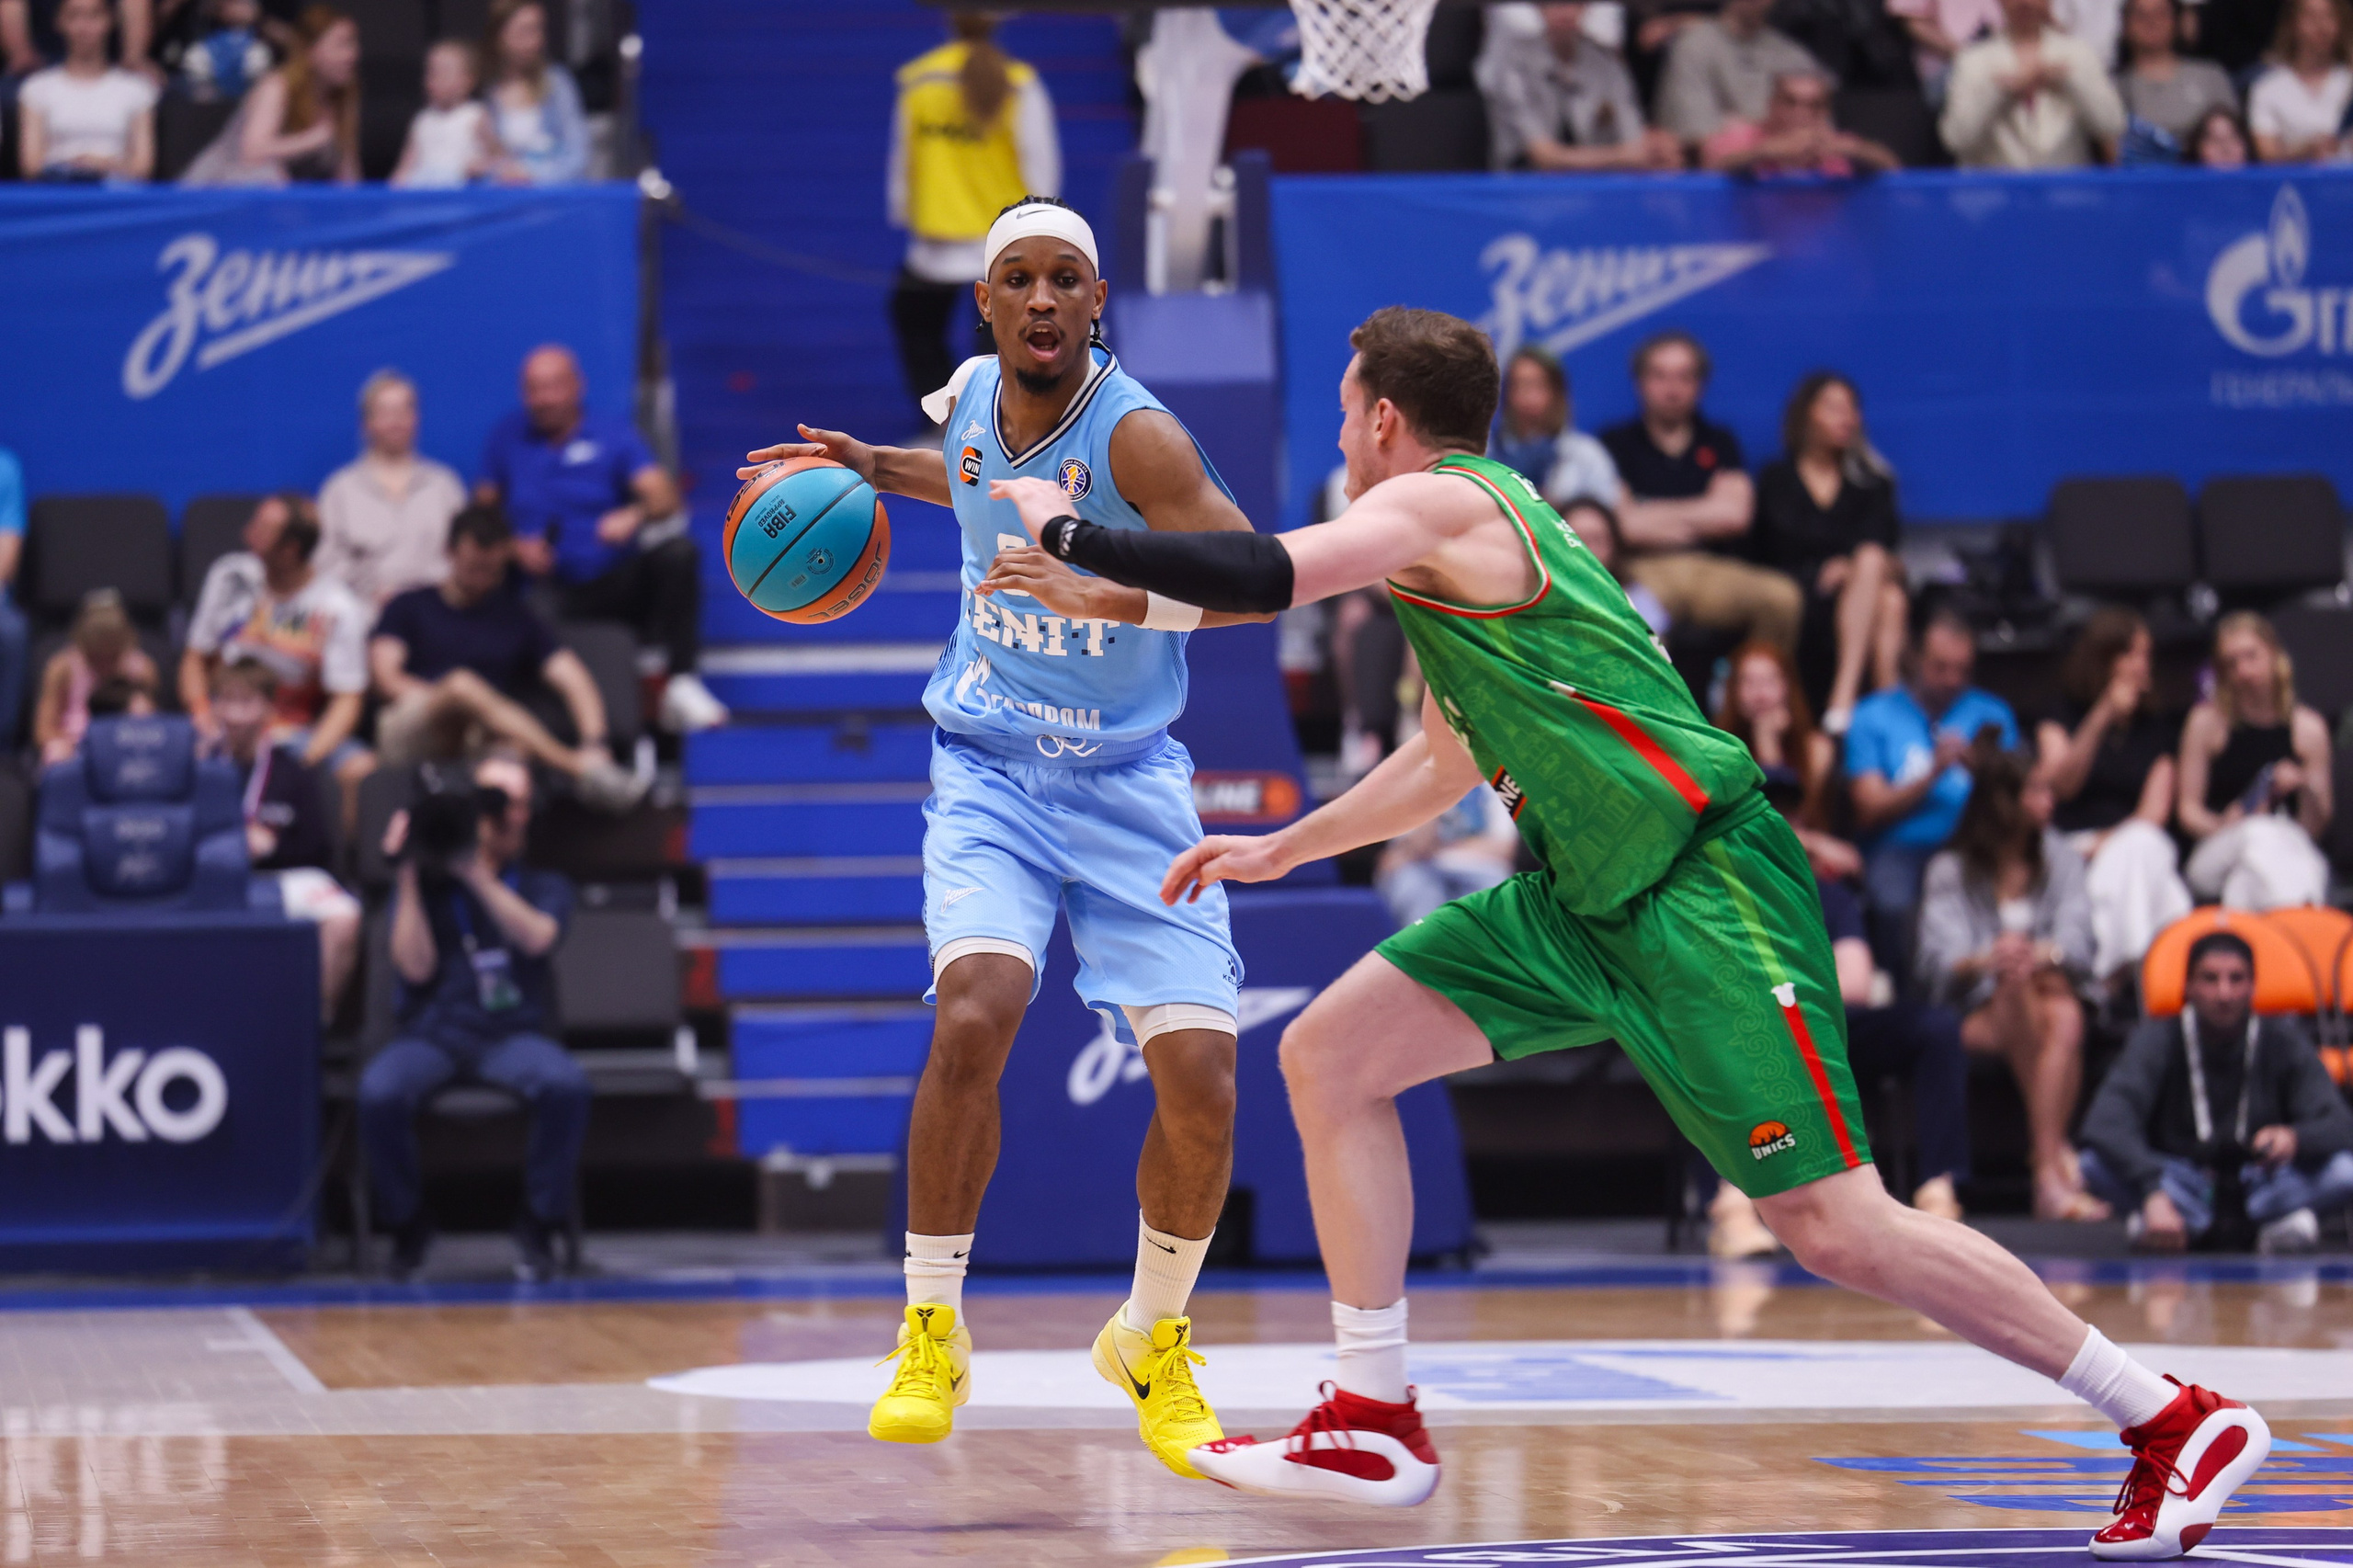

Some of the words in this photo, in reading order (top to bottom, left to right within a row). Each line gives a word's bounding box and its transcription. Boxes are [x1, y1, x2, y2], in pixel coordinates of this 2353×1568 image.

[965, 459, 981, 474] WIN
[757, 498, 785, 528] APPROVED
[763, 504, 797, 540] FIBA
[965, 588, 1120, 656] ENIT
[1222, 974, 1237, 986] KEL
[0, 1025, 228, 1143] kko
[1752, 1133, 1796, 1160] UNICS
